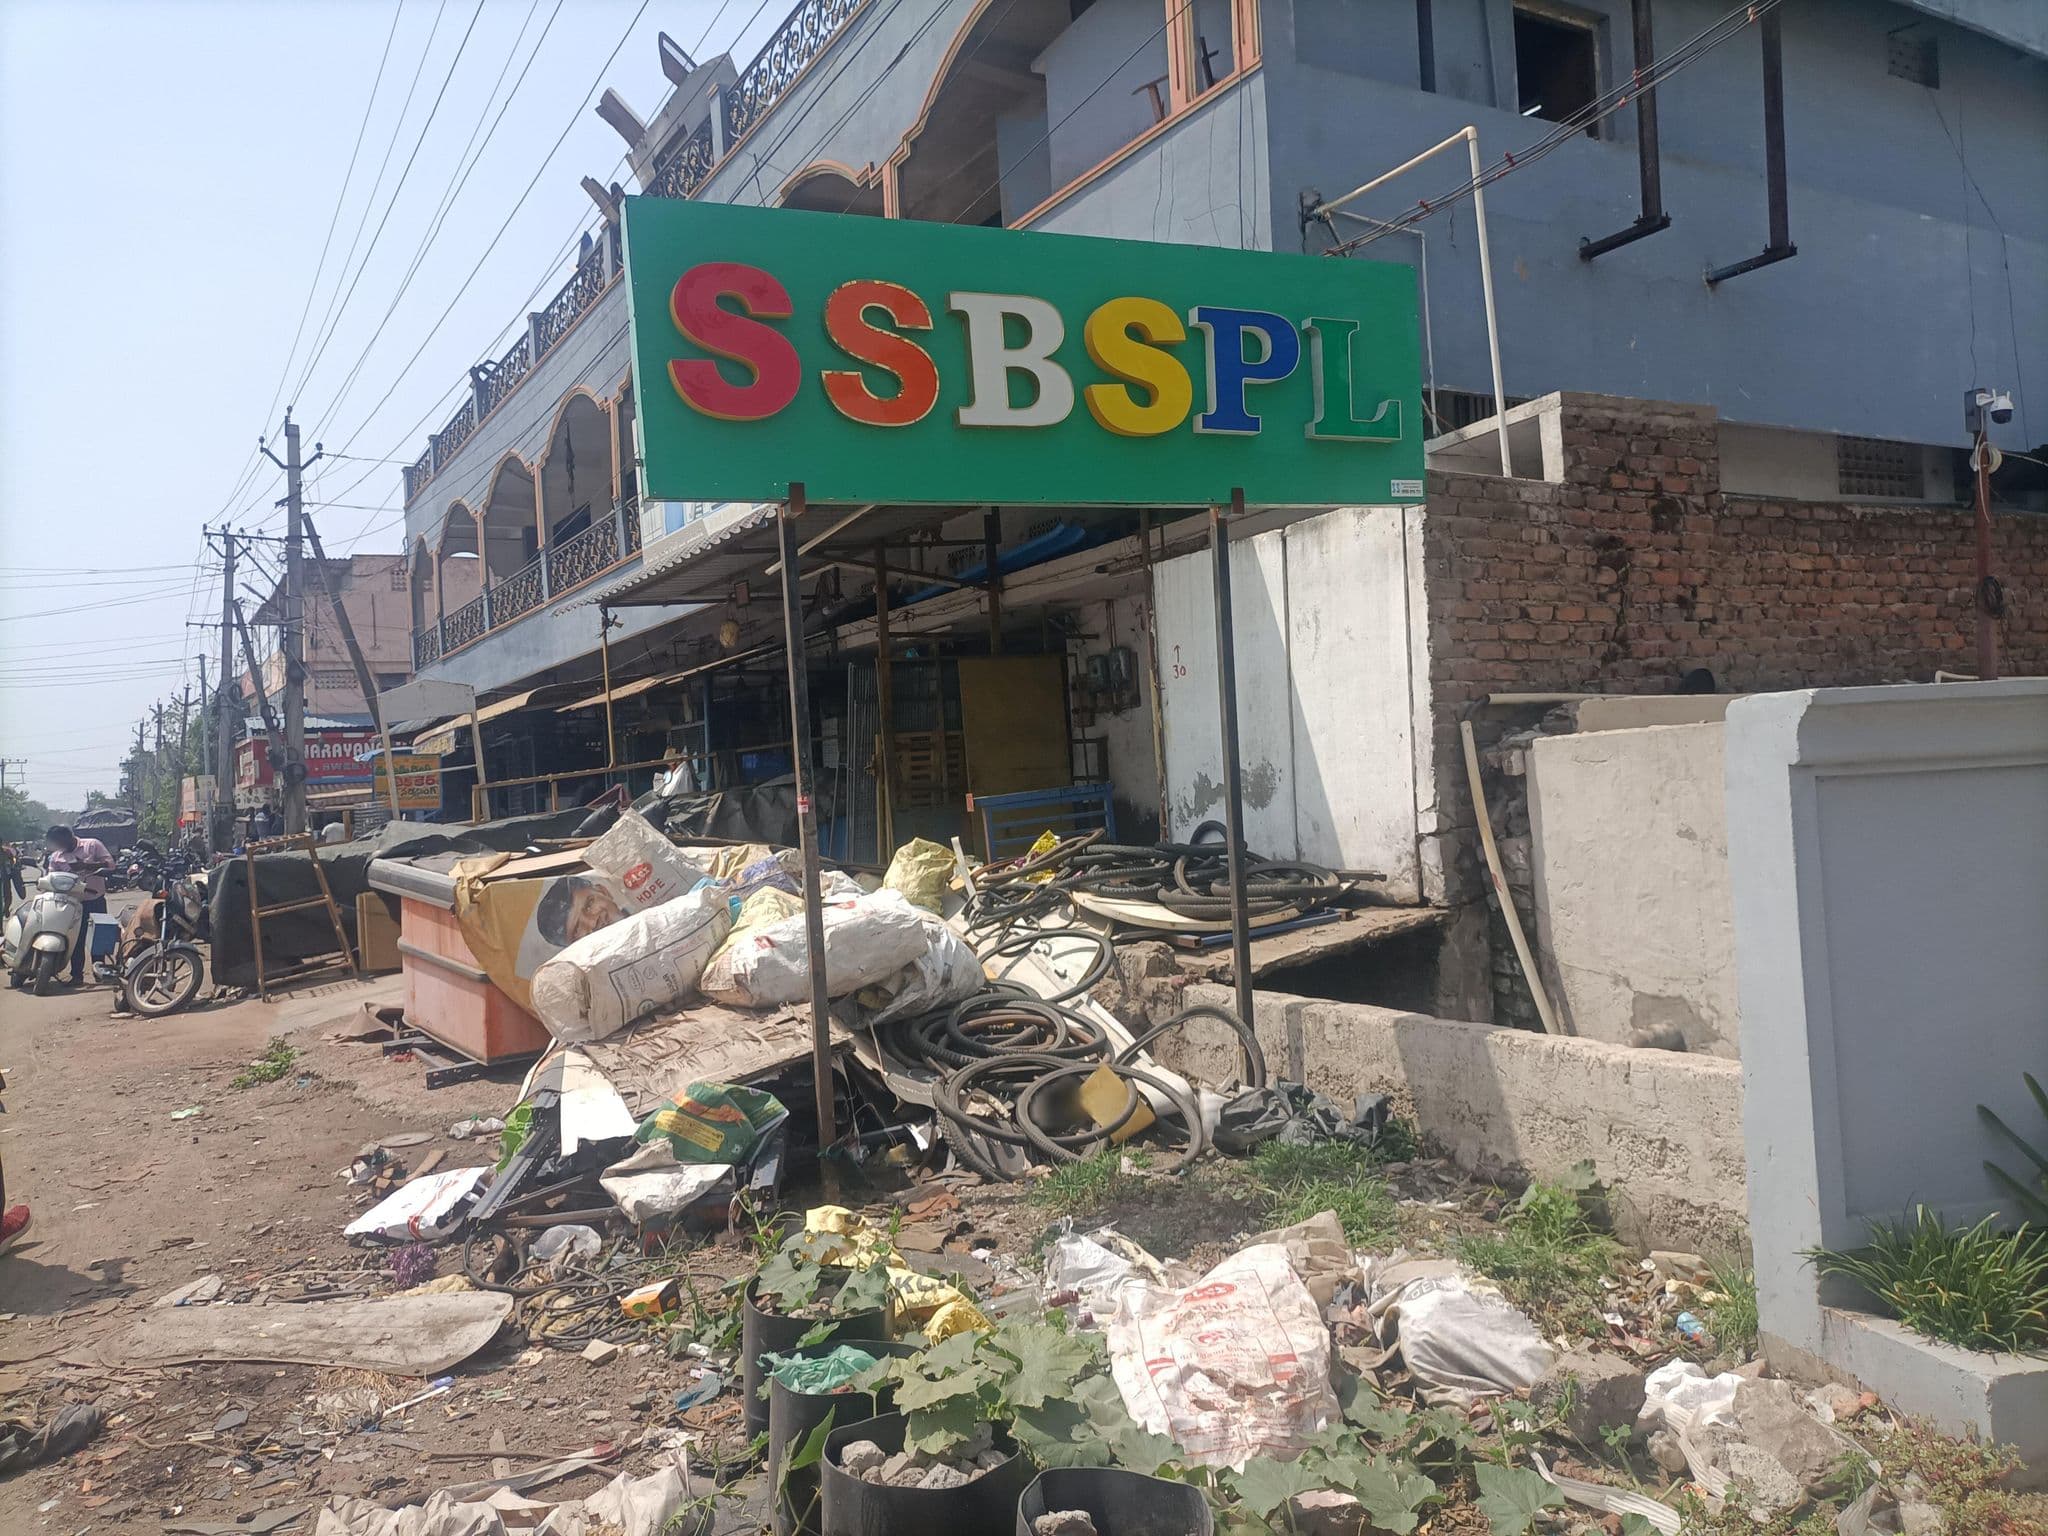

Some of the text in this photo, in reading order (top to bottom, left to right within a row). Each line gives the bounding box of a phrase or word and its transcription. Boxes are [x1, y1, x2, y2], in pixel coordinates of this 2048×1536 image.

[668, 262, 1402, 441] SSBSPL
[1172, 664, 1187, 679] 30
[636, 878, 666, 904] HDPE
